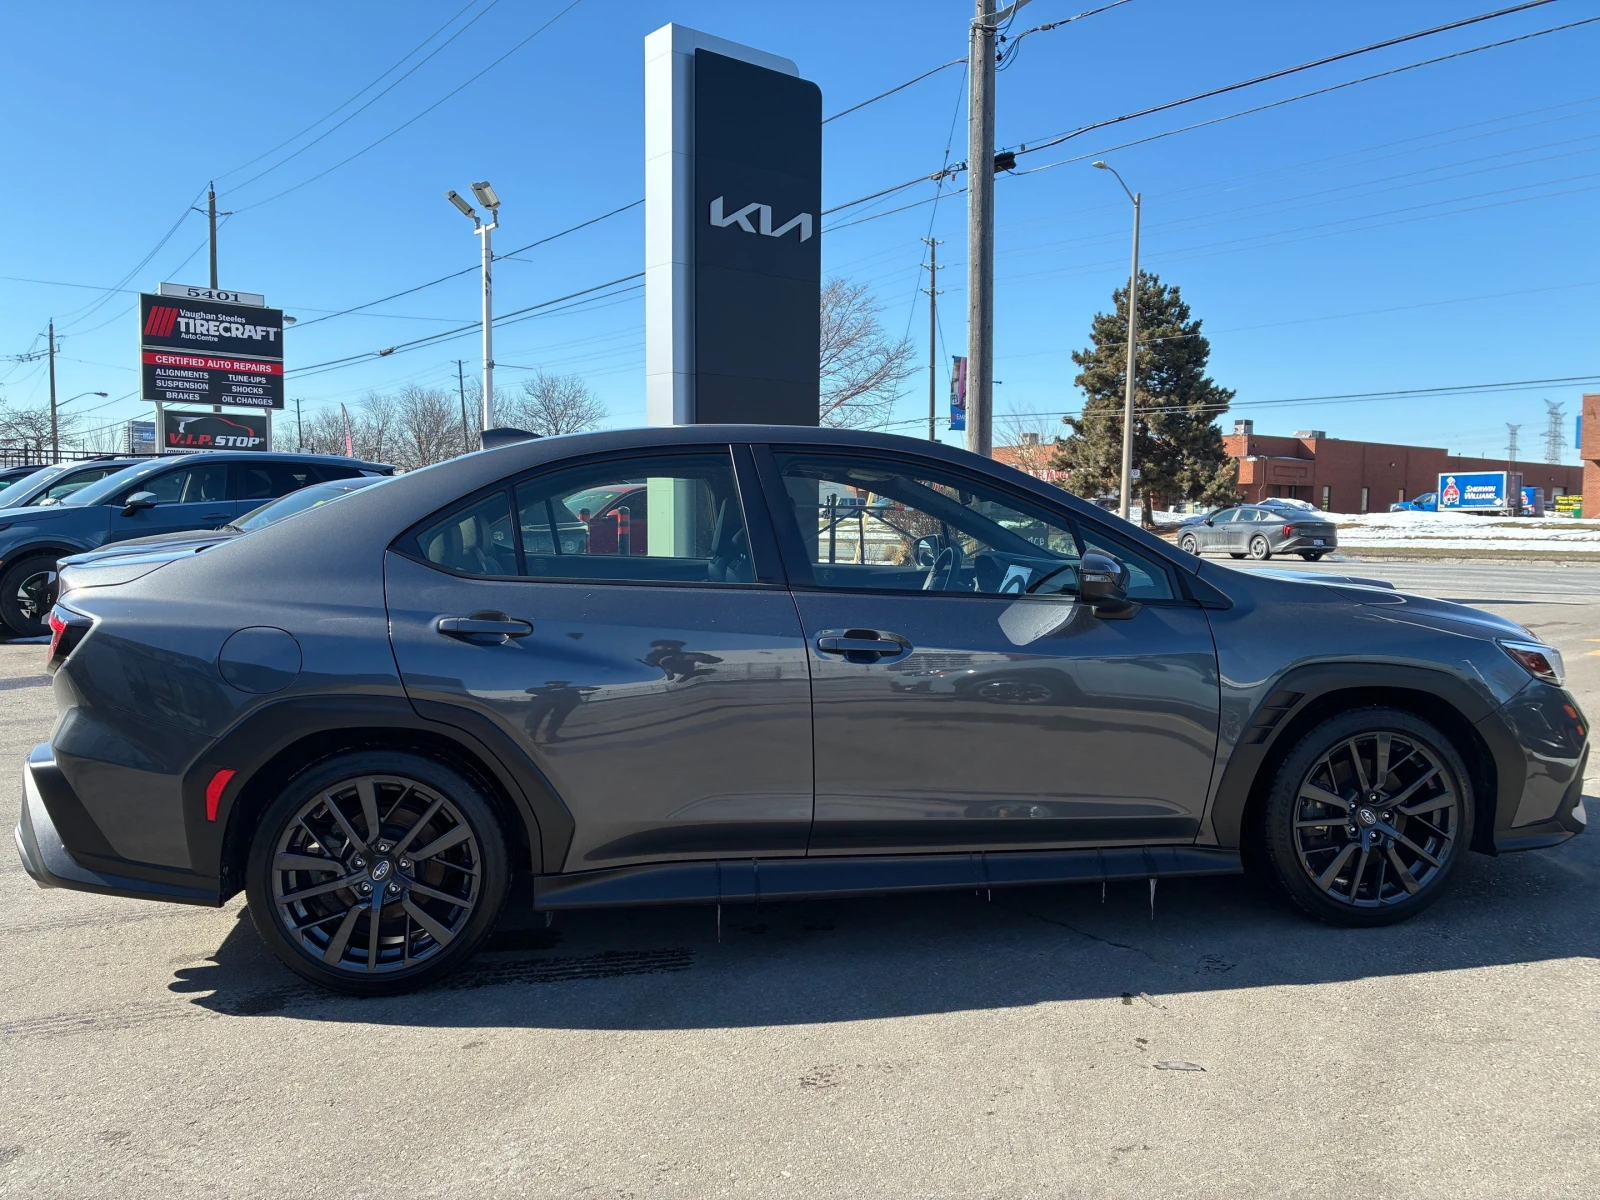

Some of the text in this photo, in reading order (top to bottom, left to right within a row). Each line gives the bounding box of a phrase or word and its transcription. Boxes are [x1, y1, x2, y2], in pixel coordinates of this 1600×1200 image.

[187, 288, 241, 303] 5401
[180, 309, 246, 324] Vaughan Steeles
[177, 317, 278, 342] TIRECRAFT
[181, 333, 196, 341] Auto
[155, 355, 271, 373] CERTIFIED AUTO REPAIRS
[155, 368, 209, 379] ALIGNMENTS
[228, 374, 266, 384] TUNE-UPS
[156, 380, 209, 390] SUSPENSION
[231, 386, 263, 395] SHOCKS
[166, 391, 200, 401] BRAKES
[222, 396, 273, 406] OIL CHANGES
[214, 435, 260, 448] STOP
[1465, 485, 1496, 493] SHERWIN
